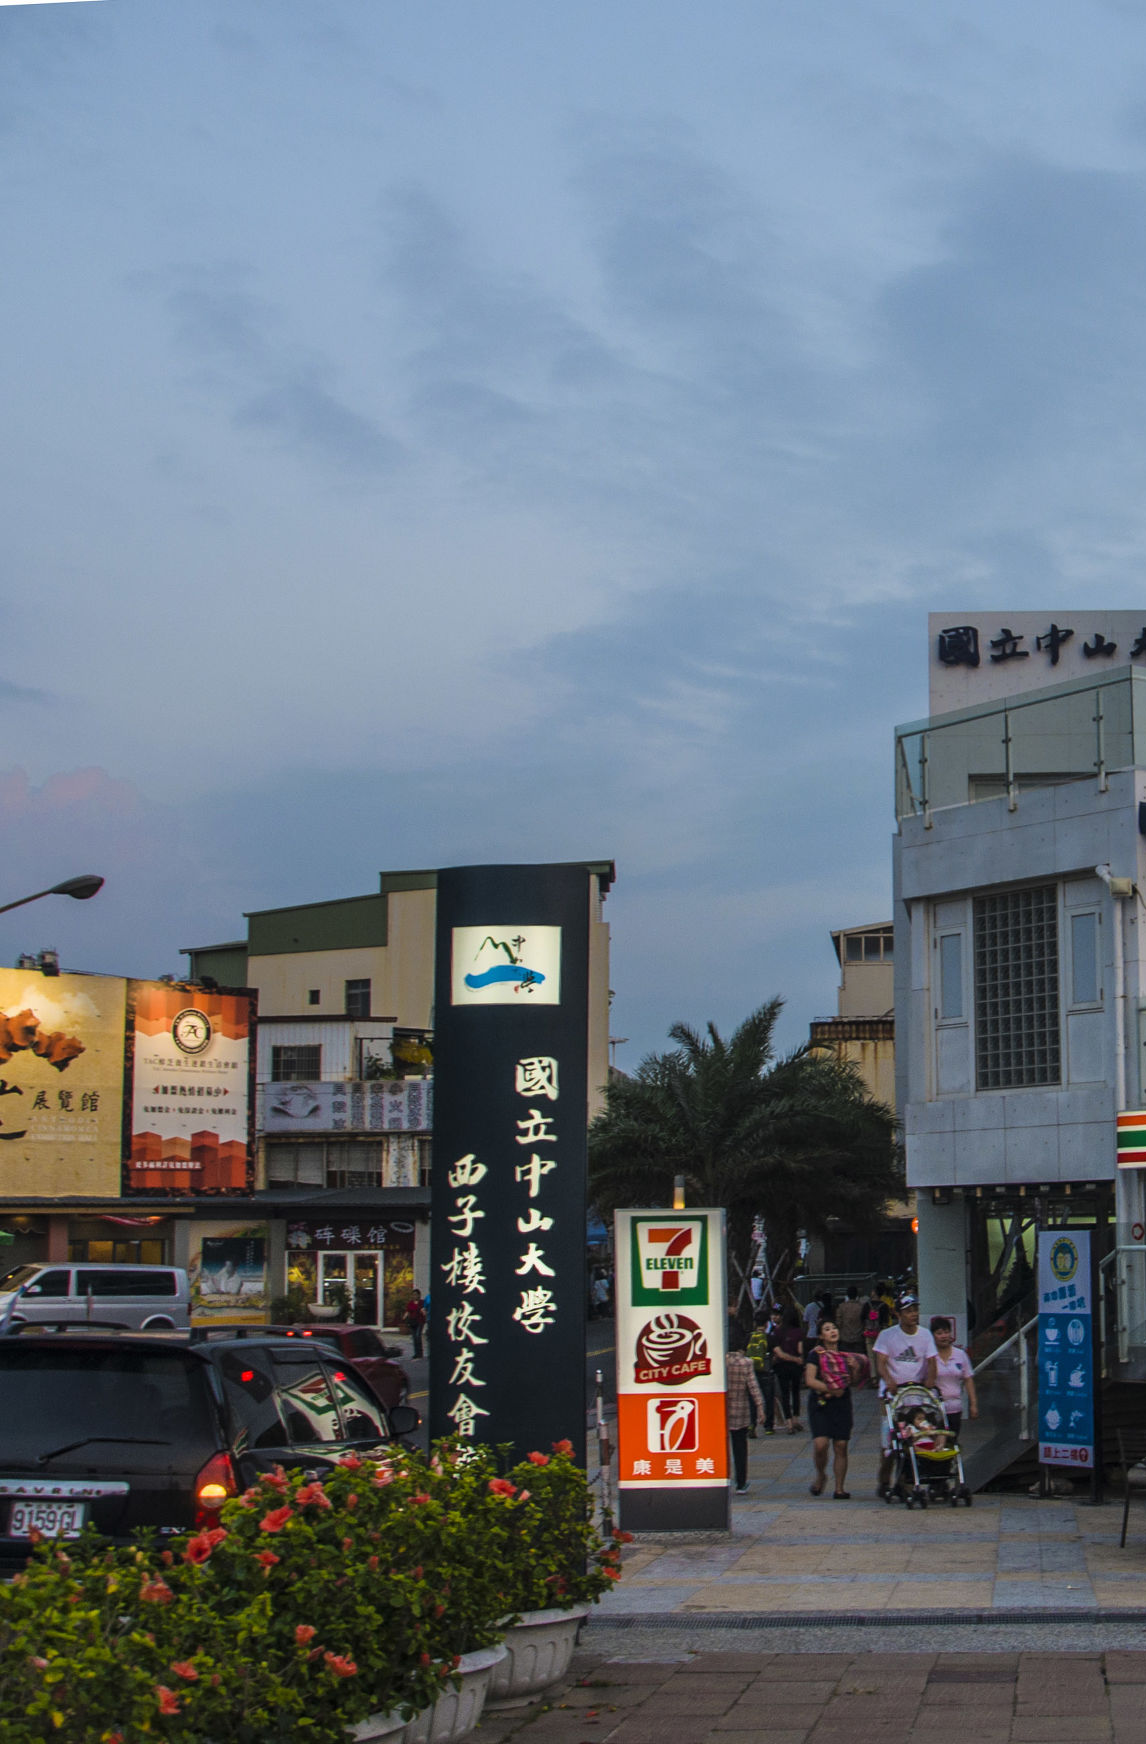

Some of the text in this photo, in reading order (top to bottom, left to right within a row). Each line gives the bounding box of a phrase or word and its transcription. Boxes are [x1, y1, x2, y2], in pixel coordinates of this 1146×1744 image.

[32, 1090, 100, 1112] 展覽館
[512, 1056, 559, 1334] 國立中山大學
[440, 1153, 491, 1478] 西子樓校友會
[639, 1360, 707, 1381] CITY CAFE
[632, 1457, 715, 1476] 康是美
